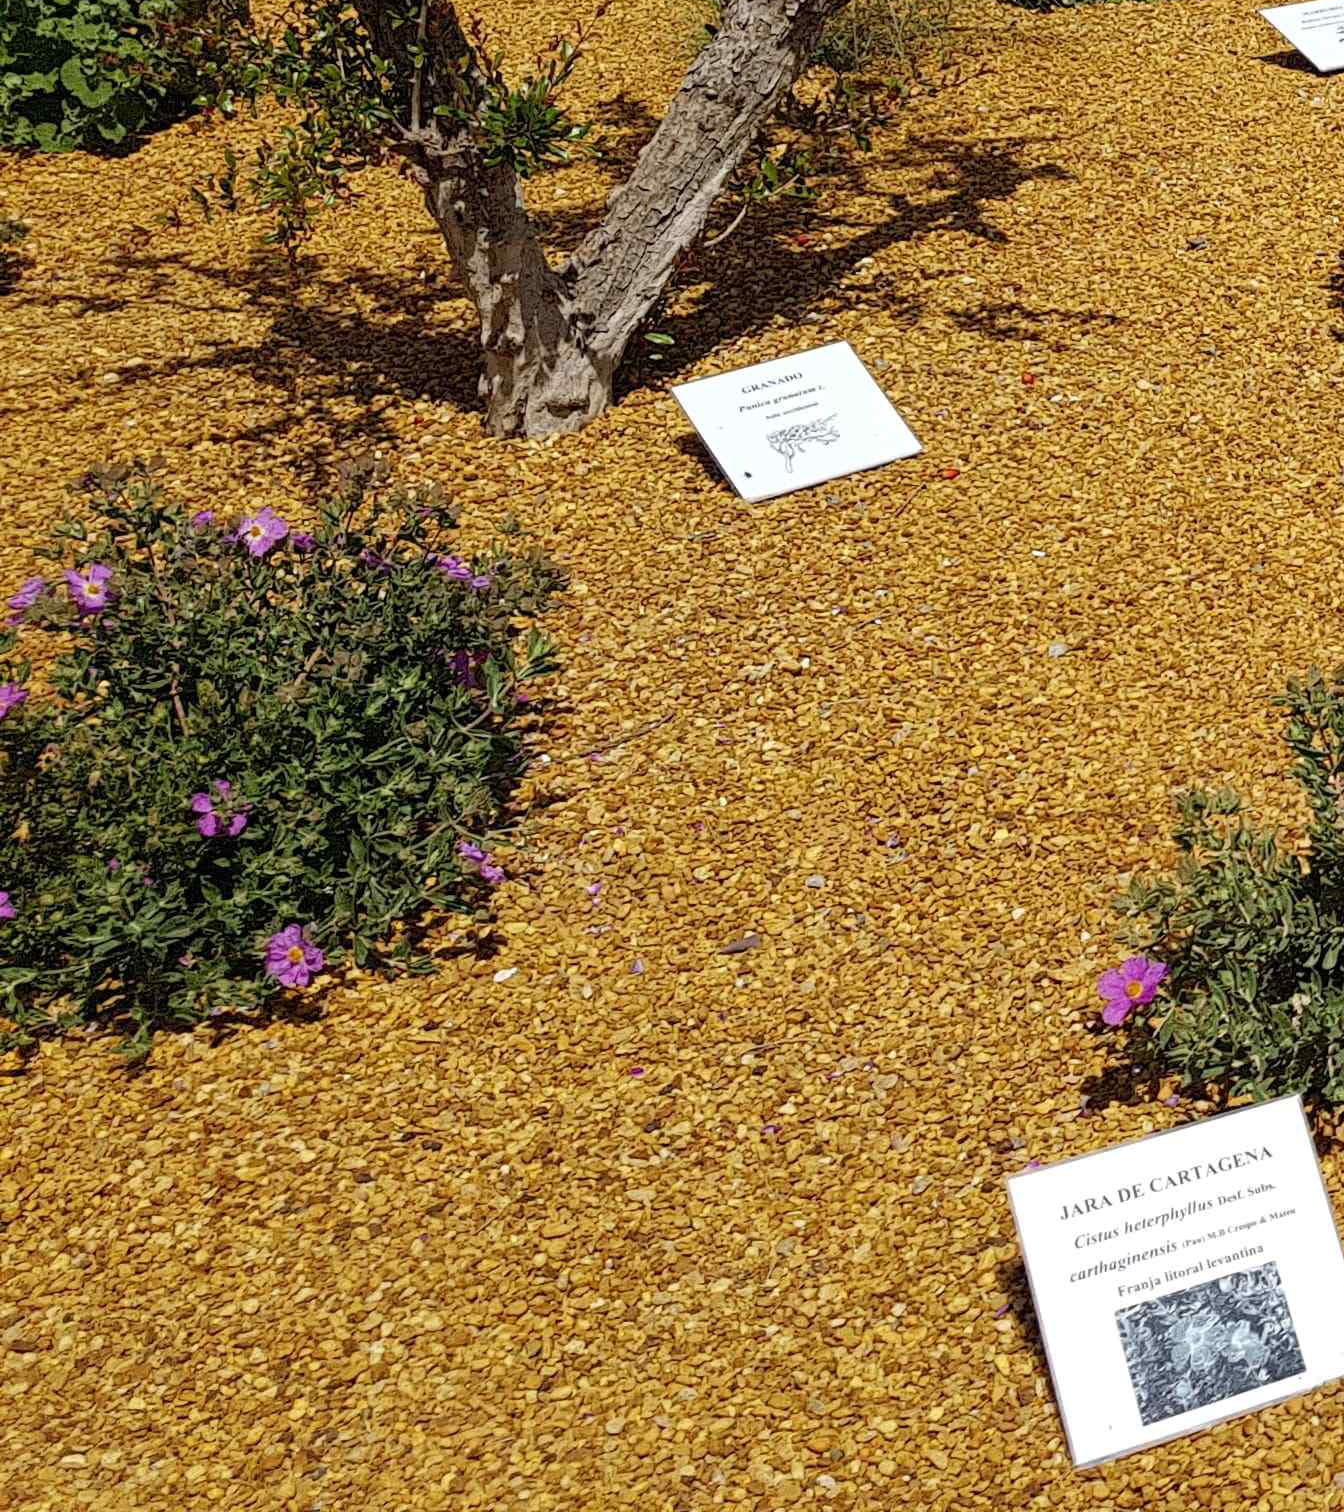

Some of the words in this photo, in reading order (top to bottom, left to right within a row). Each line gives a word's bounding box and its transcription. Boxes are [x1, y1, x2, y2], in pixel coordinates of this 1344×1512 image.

[741, 372, 803, 394] GRANADO
[1060, 1195, 1113, 1221] JARA
[1117, 1183, 1145, 1203] DE
[1149, 1146, 1273, 1193] CARTAGENA
[1074, 1227, 1119, 1249] Cistus
[1124, 1199, 1213, 1235] heterphyllus
[1069, 1240, 1177, 1283] carthaginensis
[1117, 1276, 1161, 1297] Franja
[1164, 1260, 1204, 1283] litoral
[1206, 1244, 1264, 1270] levantina
